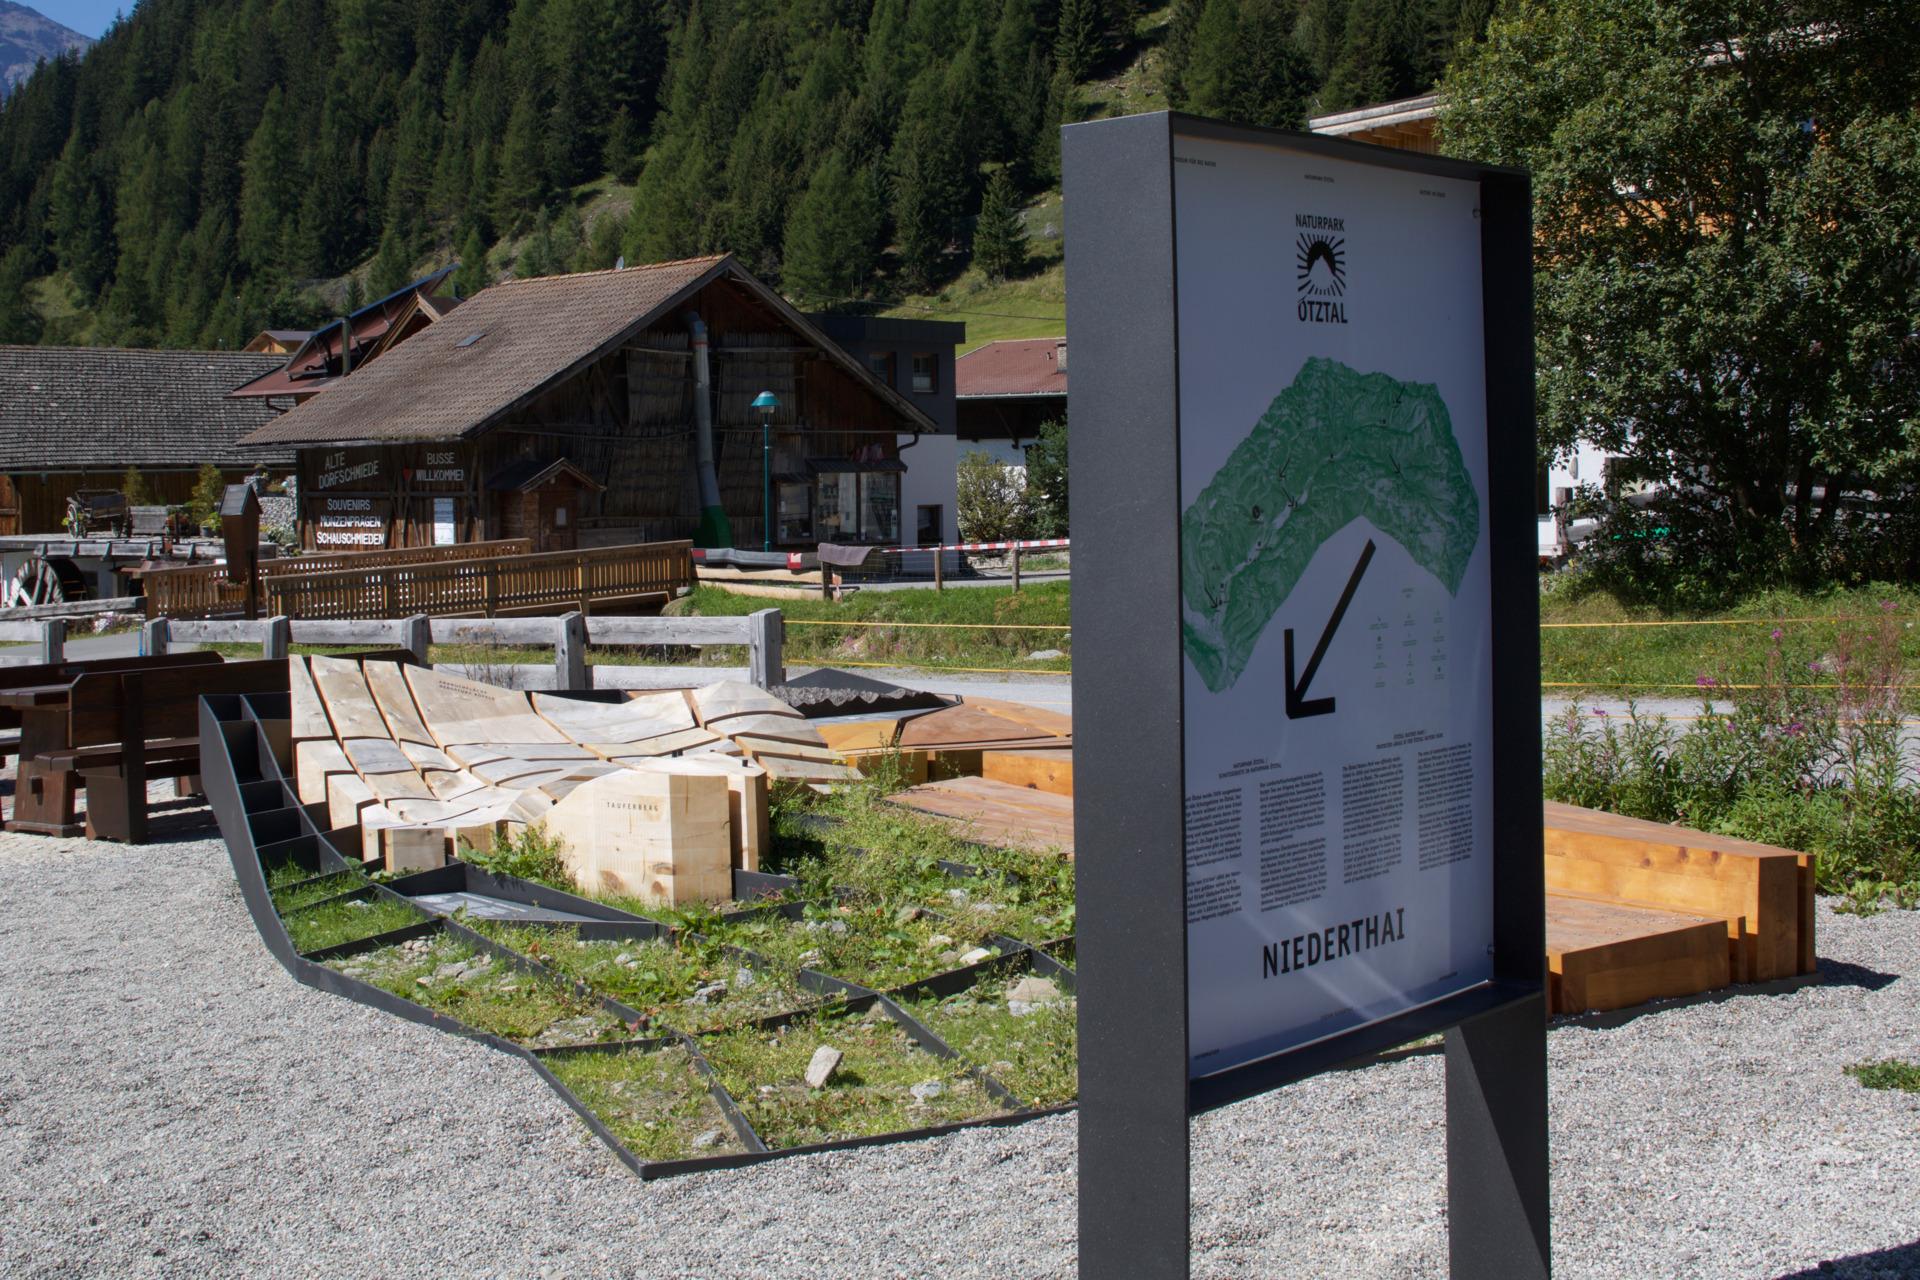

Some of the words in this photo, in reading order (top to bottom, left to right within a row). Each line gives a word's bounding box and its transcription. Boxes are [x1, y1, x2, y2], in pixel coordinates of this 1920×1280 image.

[1295, 213, 1345, 232] NATURPARK
[325, 451, 346, 471] ALTE
[427, 452, 456, 465] BUSSE
[318, 460, 380, 490] DORFSCHMIEDE
[327, 498, 372, 511] SOUVENIRS
[316, 531, 385, 545] SCHAUSCHMIEDEN
[1263, 907, 1405, 980] NIEDERTHAI
